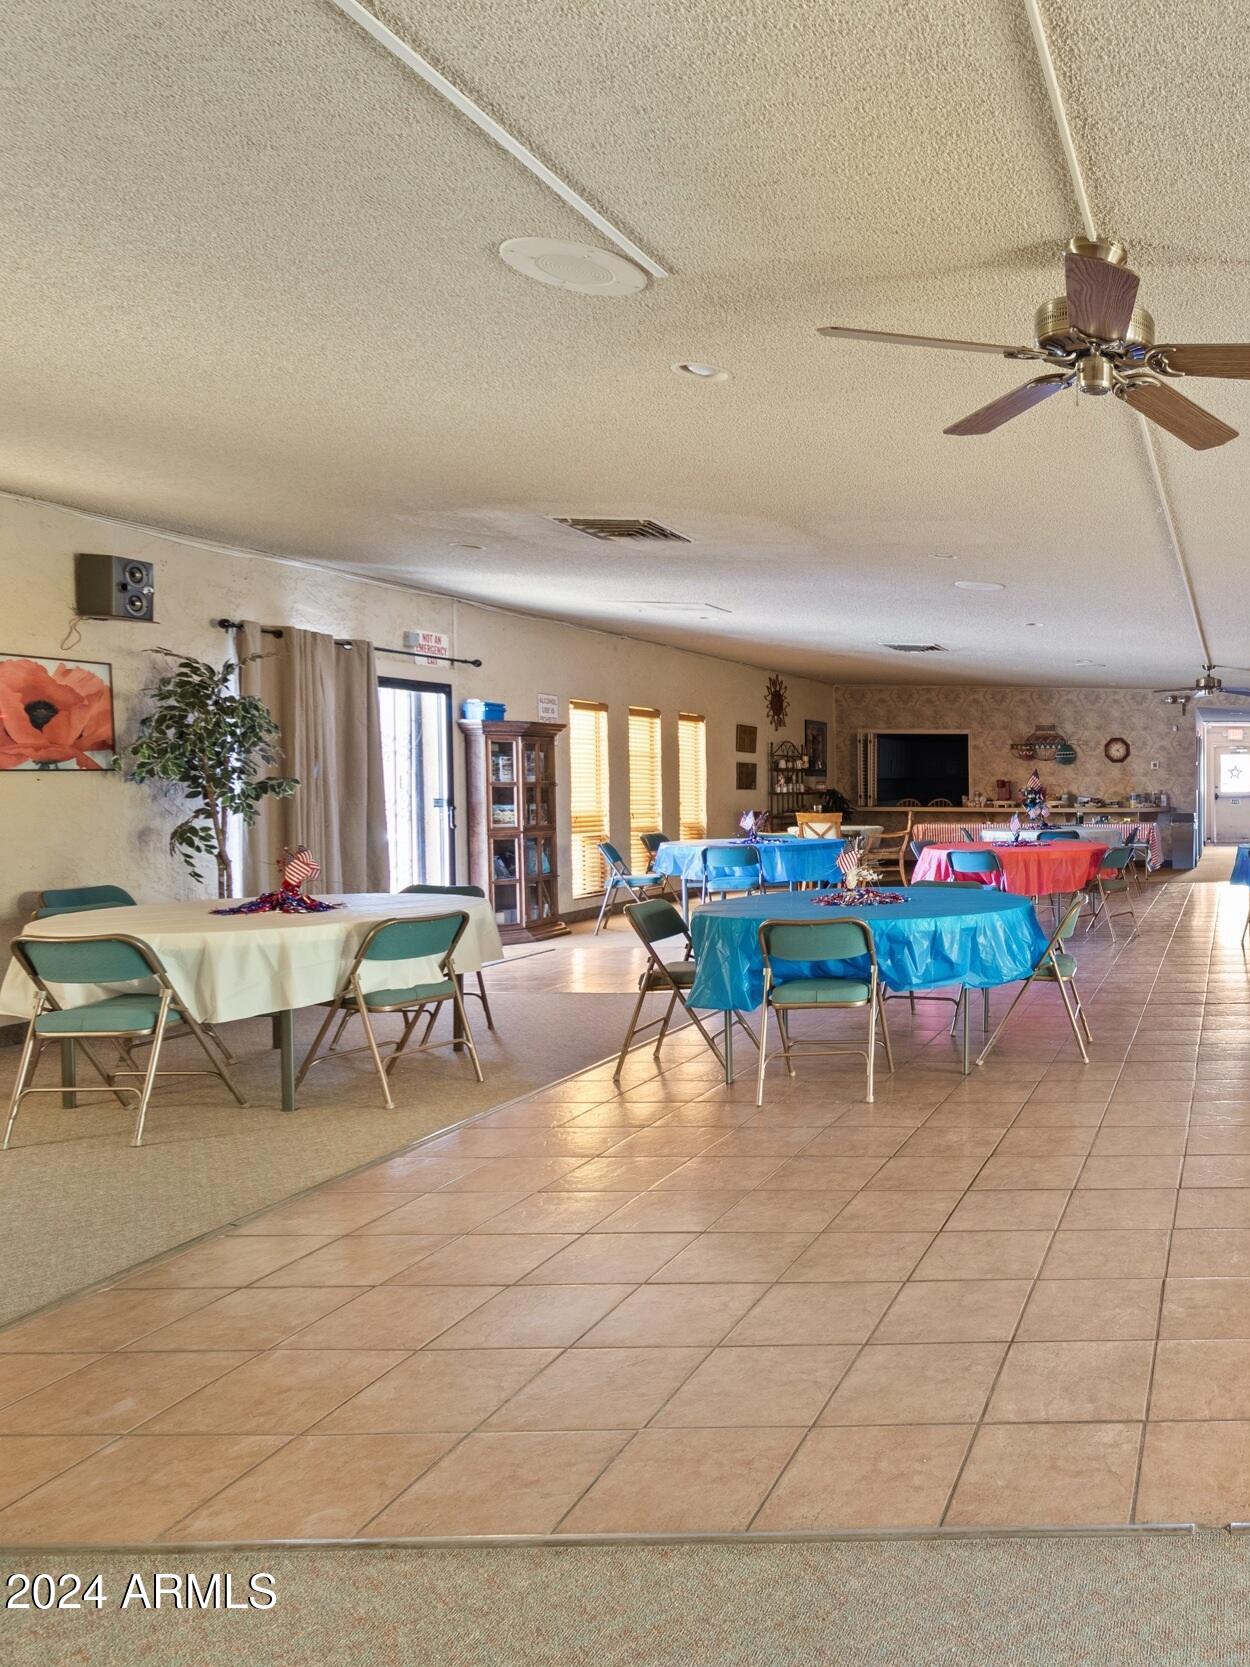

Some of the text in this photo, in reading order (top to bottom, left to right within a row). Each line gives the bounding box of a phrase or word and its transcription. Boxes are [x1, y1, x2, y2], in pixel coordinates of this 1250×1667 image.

[422, 633, 442, 645] NOT AN
[415, 643, 447, 656] EMERGENCY
